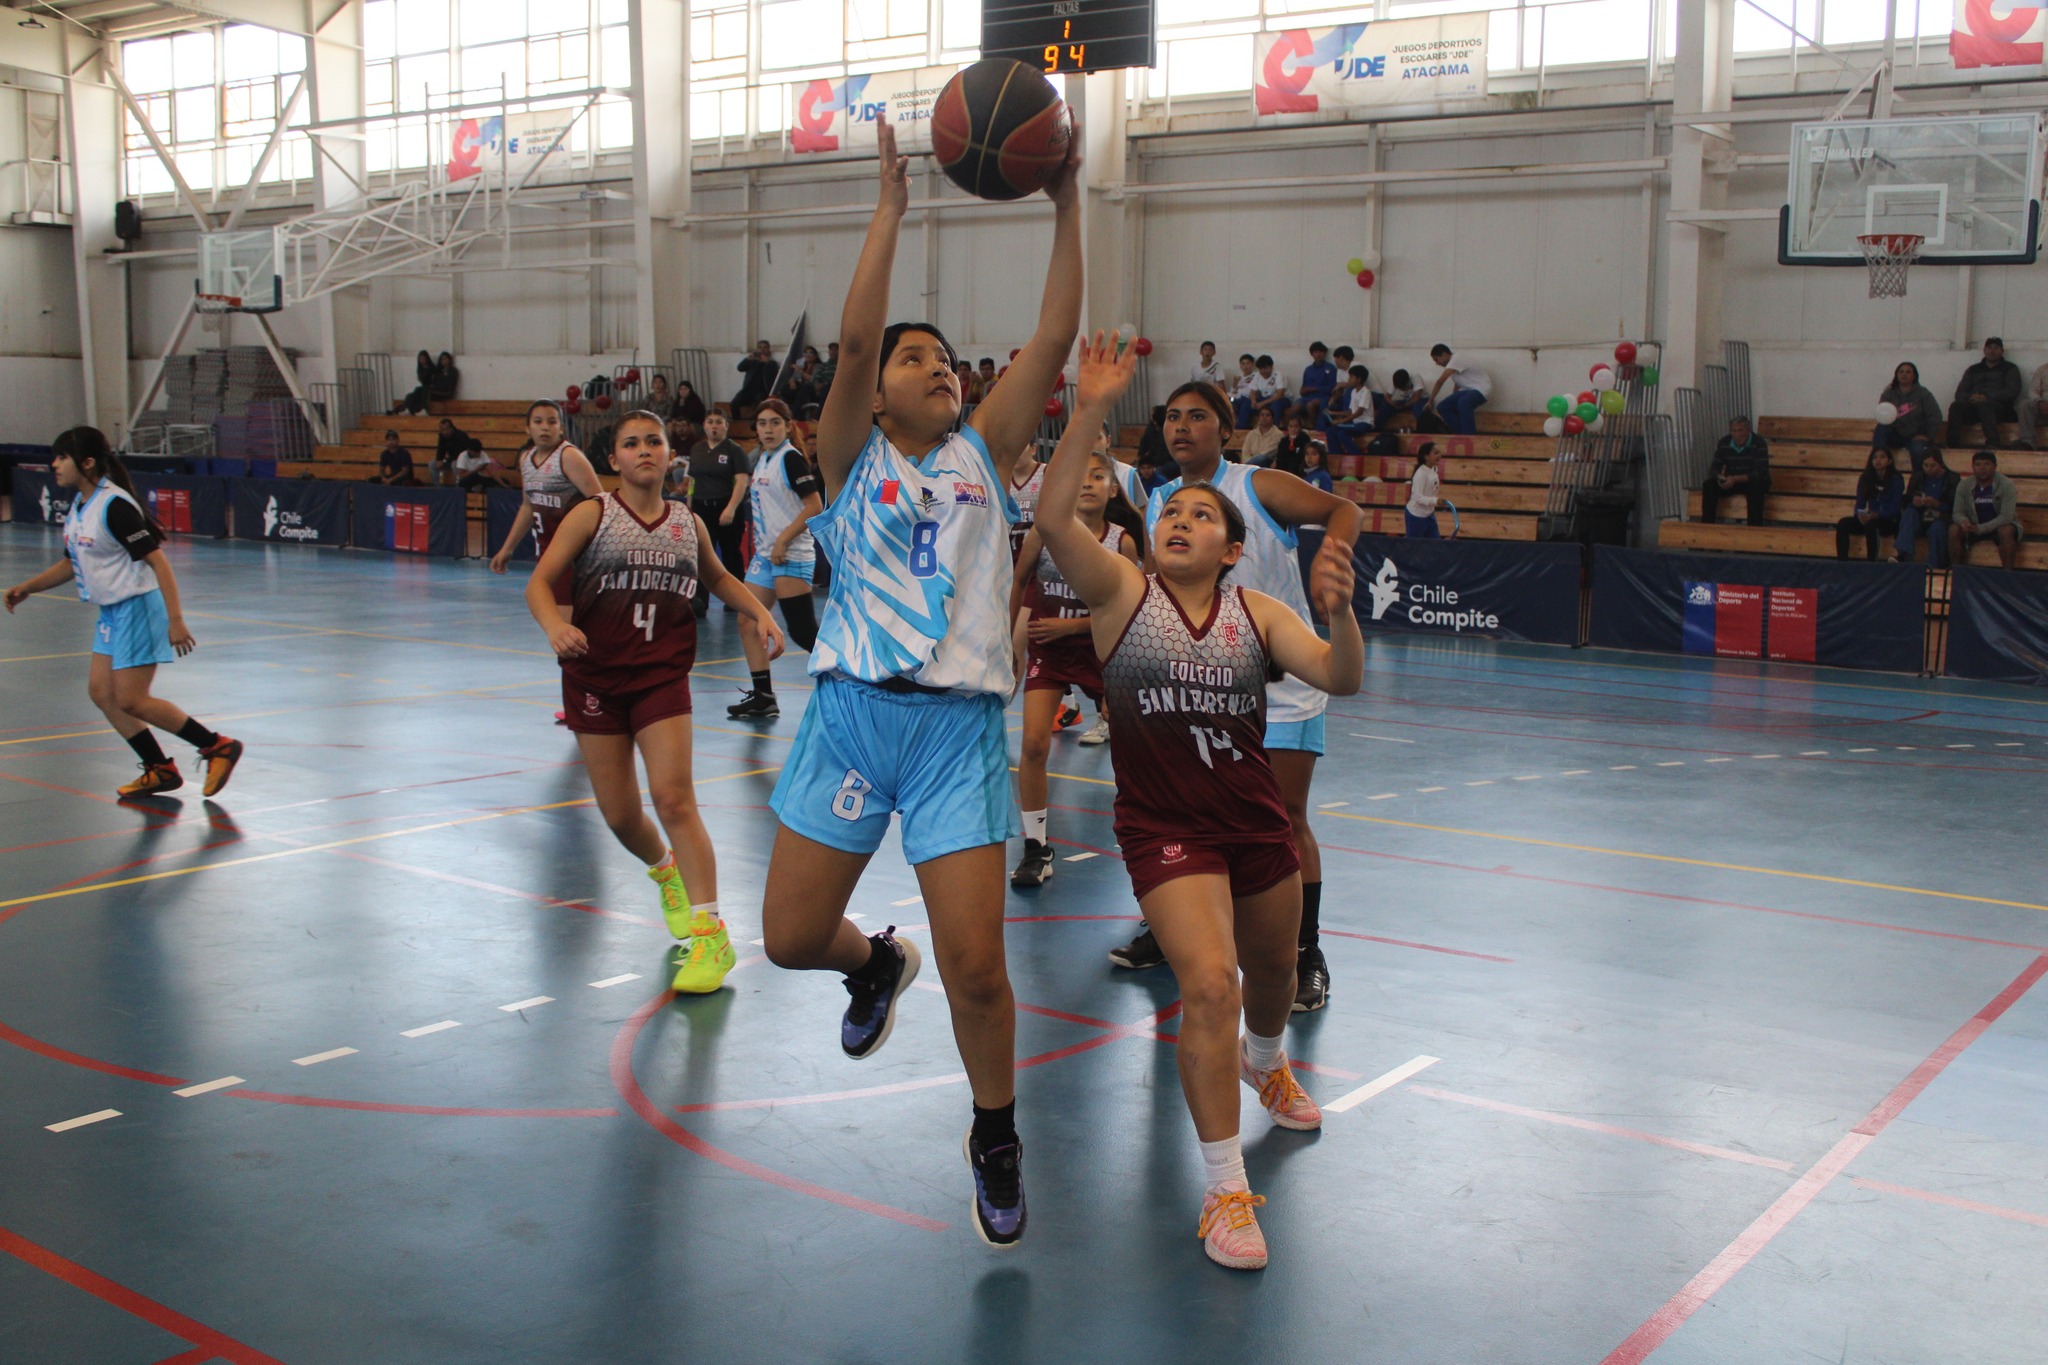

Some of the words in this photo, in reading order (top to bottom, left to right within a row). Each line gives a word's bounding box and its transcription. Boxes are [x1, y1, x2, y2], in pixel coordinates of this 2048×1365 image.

[1053, 2, 1080, 15] FALTAS
[1063, 19, 1071, 39] 1
[1392, 43, 1426, 54] JUEGOS
[1428, 38, 1482, 50] DEPORTIVOS
[1400, 51, 1448, 64] ESCOLARES
[1402, 63, 1470, 80] ATACAMA
[891, 91, 915, 100] JUEGOS
[898, 109, 934, 122] ATACA
[280, 511, 302, 525] Chile
[279, 525, 319, 541] Compite
[627, 550, 676, 568] COLEGIO
[909, 521, 941, 578] 8
[597, 570, 628, 594] SAN
[631, 570, 698, 600] LORENZO
[1043, 581, 1063, 597] SAN
[1408, 584, 1459, 605] Chile
[633, 603, 657, 642] 4
[1408, 605, 1499, 632] Compite
[99, 622, 111, 643] 4
[1169, 660, 1234, 687] COLEGIO
[1137, 686, 1176, 716] SAN
[1179, 686, 1257, 716] LORENZO
[1189, 725, 1244, 770] 14
[830, 767, 874, 823] 8
